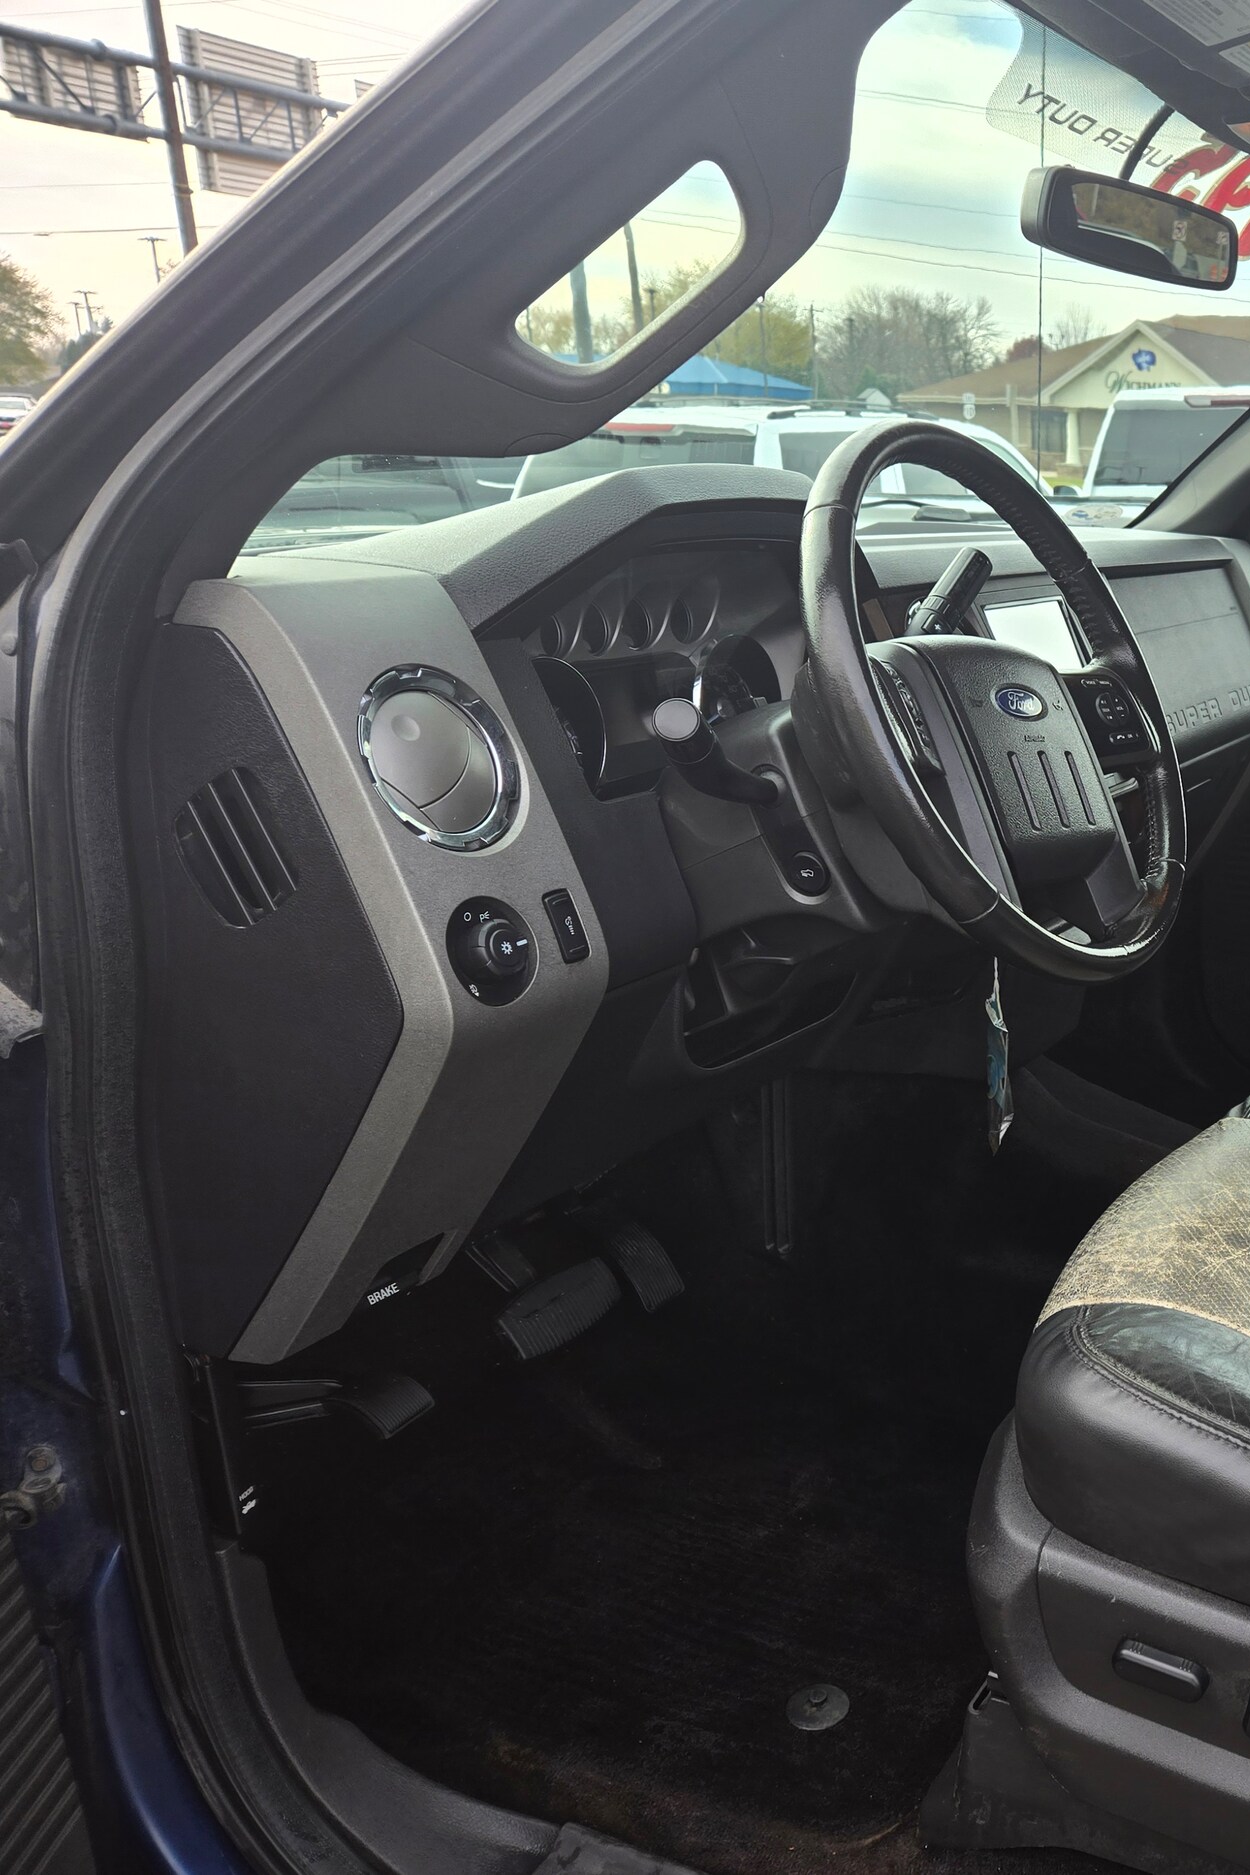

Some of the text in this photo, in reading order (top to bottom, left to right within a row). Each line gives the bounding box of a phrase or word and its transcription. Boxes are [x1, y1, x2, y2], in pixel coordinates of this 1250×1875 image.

[1007, 691, 1035, 711] Ford
[366, 1282, 400, 1306] BRAKE
[238, 1485, 254, 1502] HOOD
